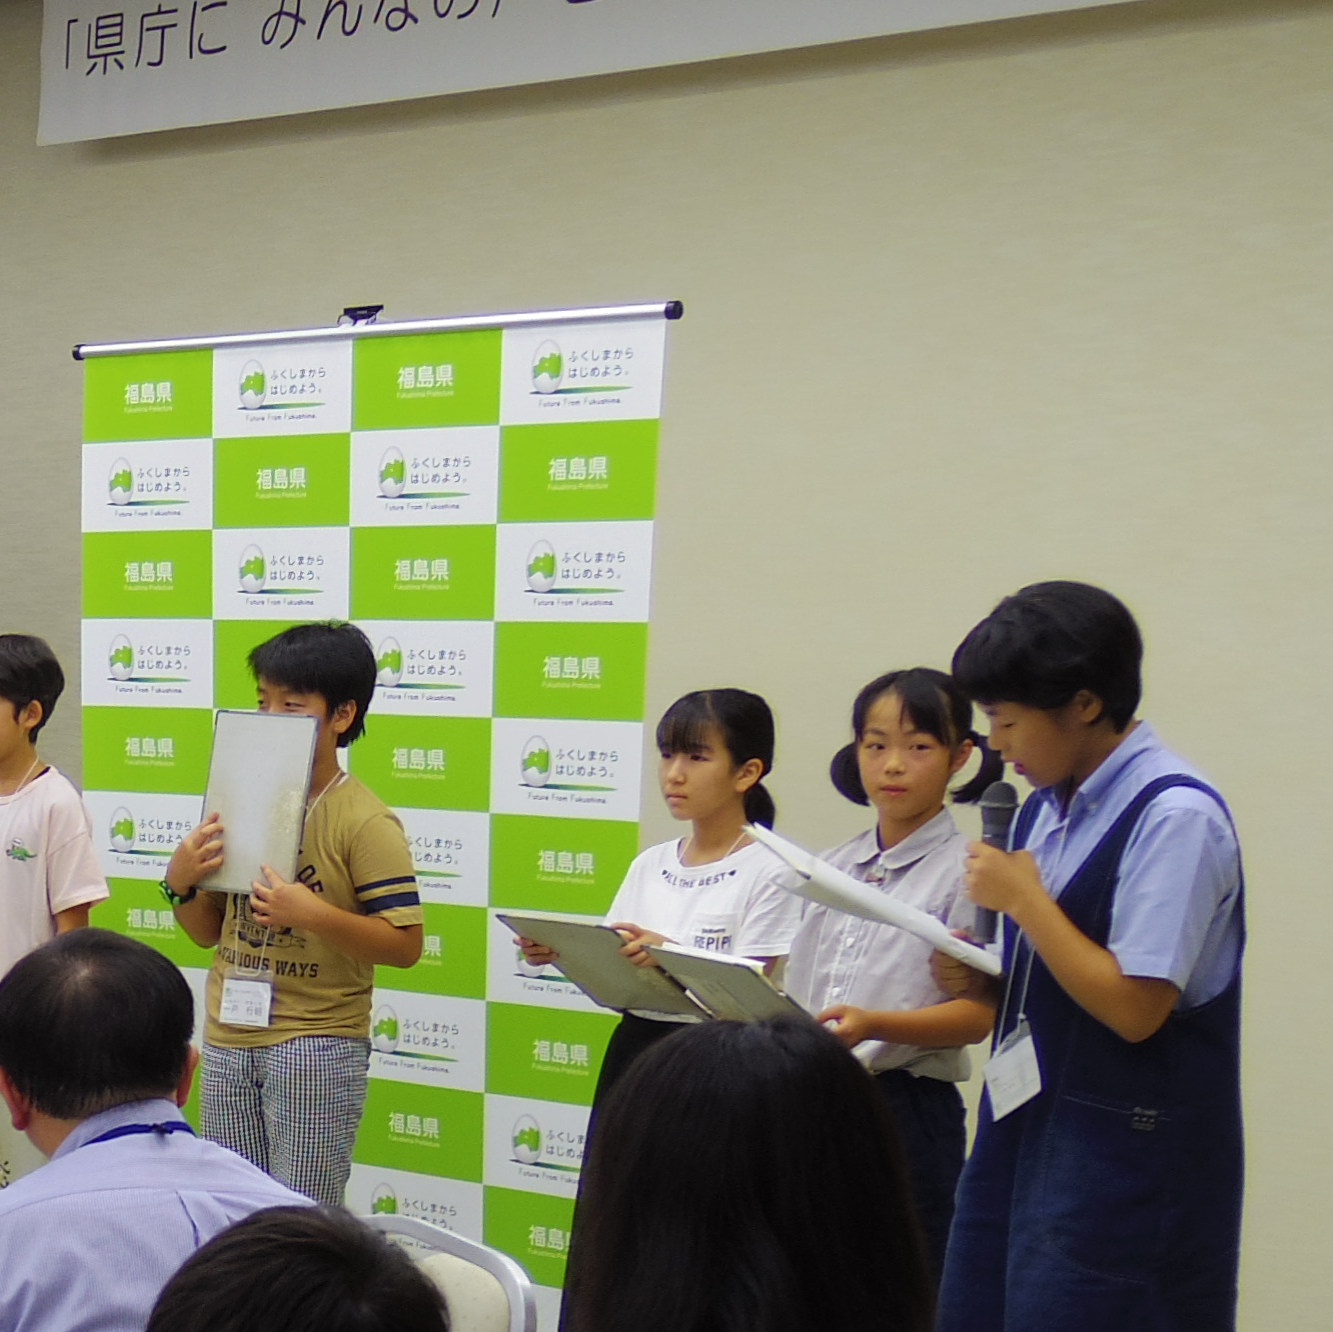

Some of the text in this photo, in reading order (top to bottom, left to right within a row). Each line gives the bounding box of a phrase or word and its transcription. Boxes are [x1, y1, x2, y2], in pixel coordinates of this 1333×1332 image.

[569, 348, 633, 362] ふくしまから
[271, 367, 326, 379] ふくしまから
[397, 364, 453, 389] 福島県
[125, 382, 171, 404] 福島県
[411, 457, 471, 468] ふくしまから
[549, 456, 607, 480] 福島県
[137, 467, 189, 478] ふくしまから
[256, 468, 305, 490] 福島県
[270, 555, 324, 566] ふくしまから
[562, 552, 625, 563] ふくしまから
[125, 562, 172, 583] 福島県
[395, 559, 449, 581] 福島県
[138, 645, 191, 656] ふくしまから
[407, 650, 466, 661] ふくしまから
[543, 656, 600, 679] 福島県
[125, 737, 174, 758] 福島県
[556, 751, 618, 762] ふくしまから
[392, 748, 445, 770] 福島県
[139, 819, 191, 831] ふくしまから
[139, 833, 183, 843] はじめよう
[414, 853, 458, 864] じめよう。
[538, 851, 593, 874] 福島県
[698, 872, 726, 886] BEST
[127, 909, 175, 930] 福島県
[276, 960, 319, 978] WAYS
[404, 1019, 459, 1034] ふくしまから
[533, 1039, 588, 1066] 福島県
[389, 1111, 439, 1139] 福島県
[547, 1130, 584, 1143] ふくしま
[403, 1198, 456, 1216] ふくしまから
[529, 1225, 570, 1250] 福島
